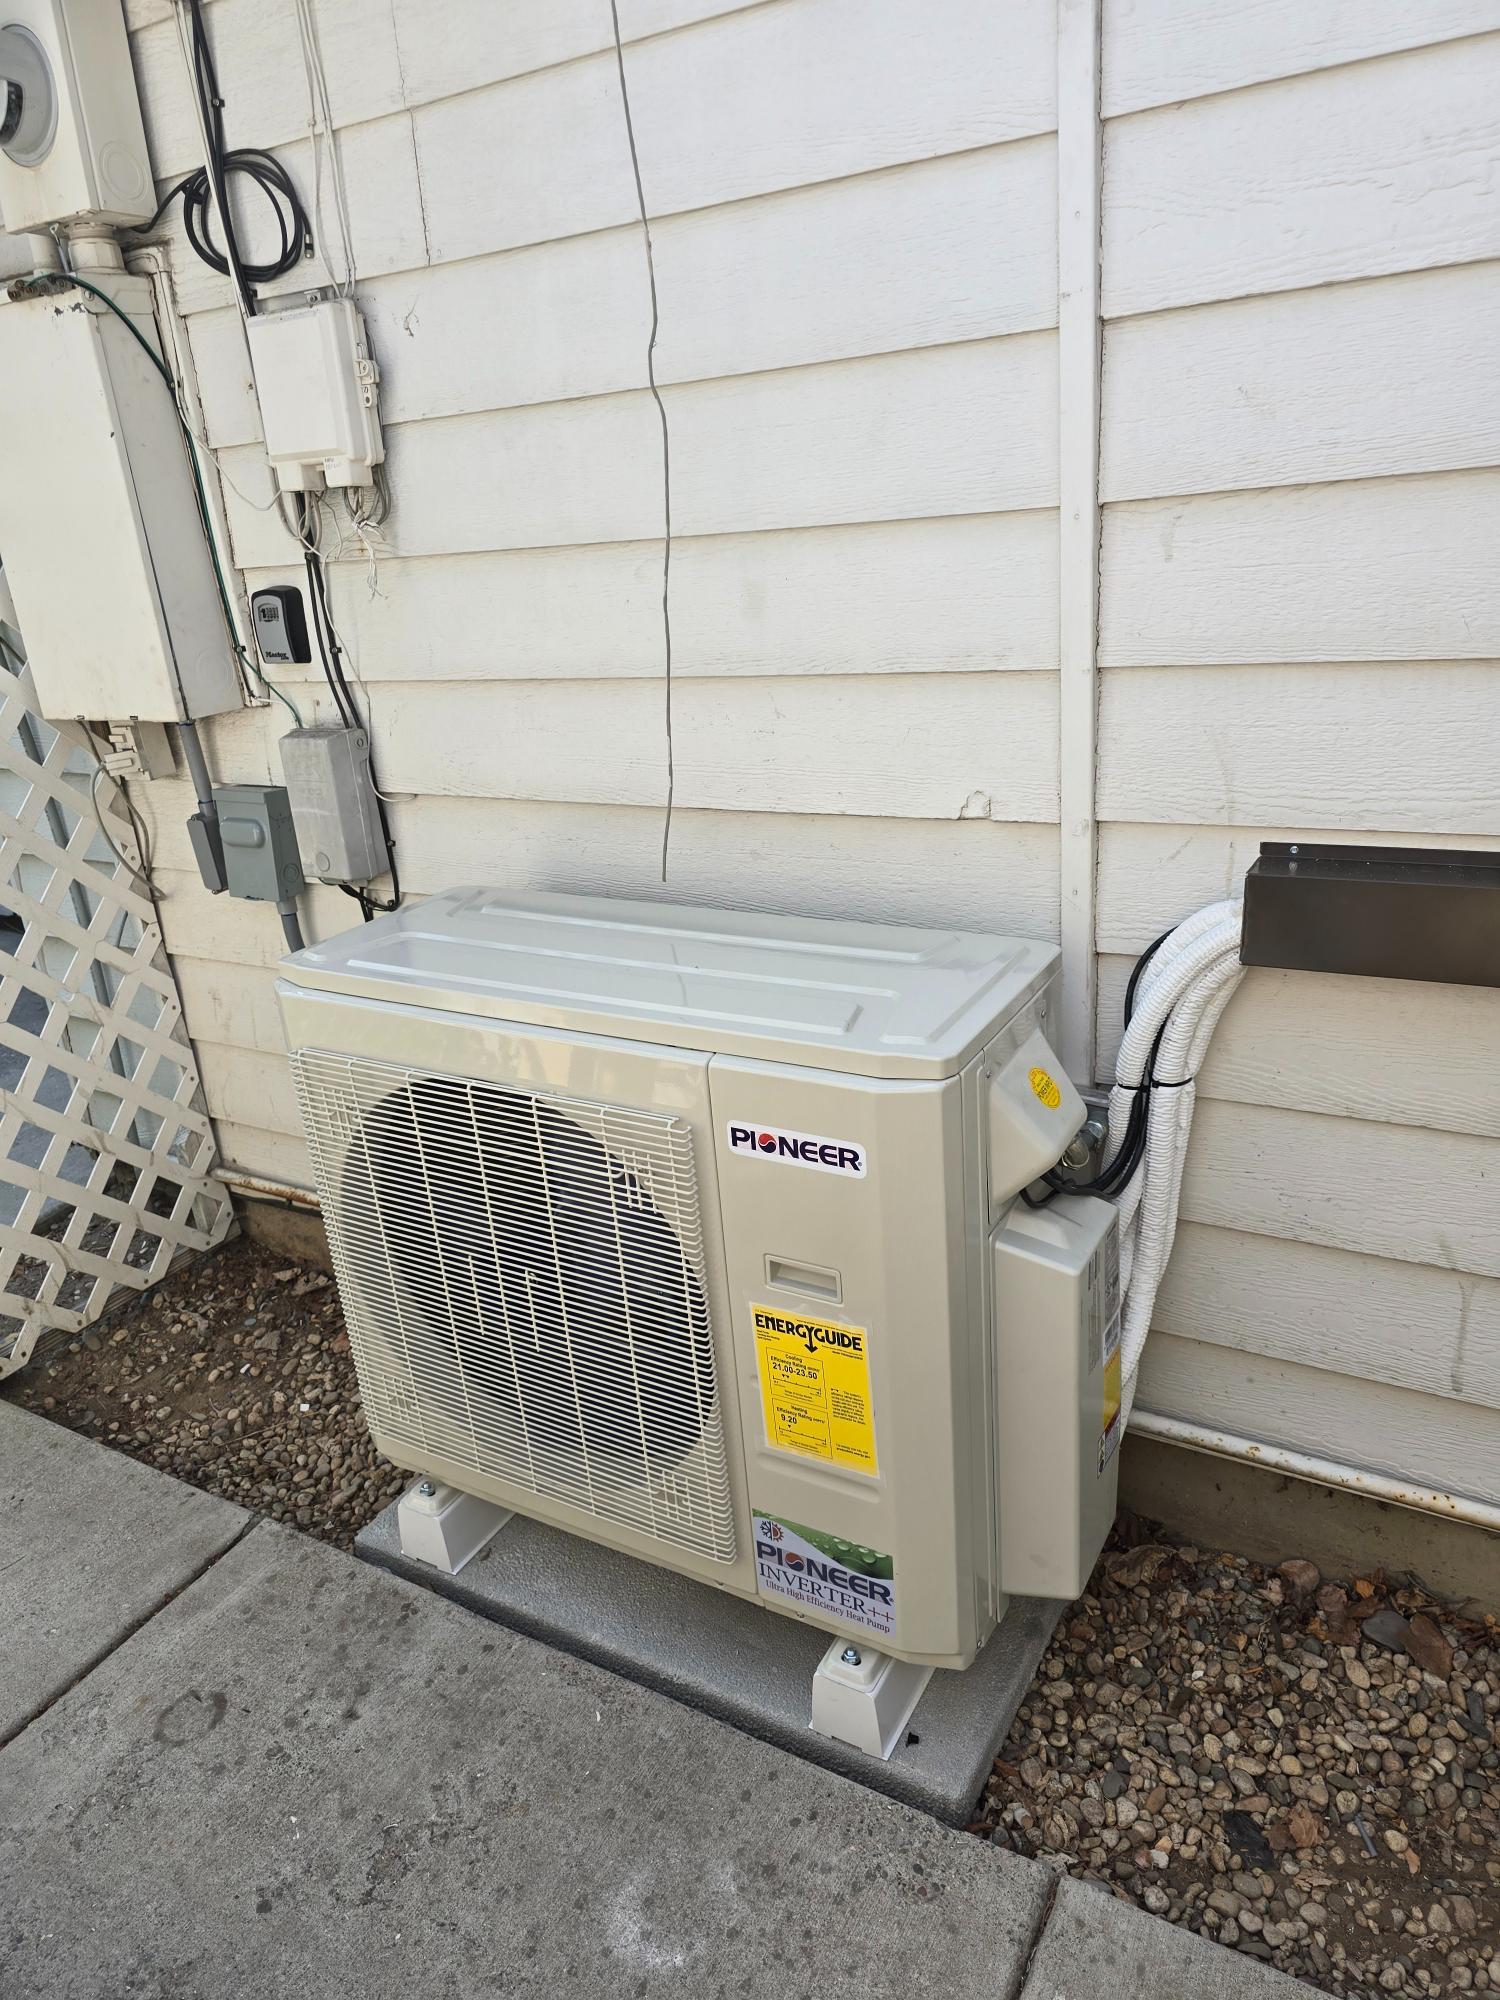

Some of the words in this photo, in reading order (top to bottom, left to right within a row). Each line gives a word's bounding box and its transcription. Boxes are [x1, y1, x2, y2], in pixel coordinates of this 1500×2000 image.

[731, 1127, 860, 1171] PIONEER
[755, 1313, 863, 1352] ENERGYGUIDE
[772, 1361, 817, 1379] 21.00-23.50
[781, 1413, 797, 1424] 9.20
[757, 1540, 892, 1606] PIONEER
[766, 1580, 785, 1593] Ultra
[787, 1586, 805, 1601] High
[806, 1594, 844, 1616] Efficiency
[846, 1610, 865, 1624] Heat
[867, 1618, 890, 1633] Pump
